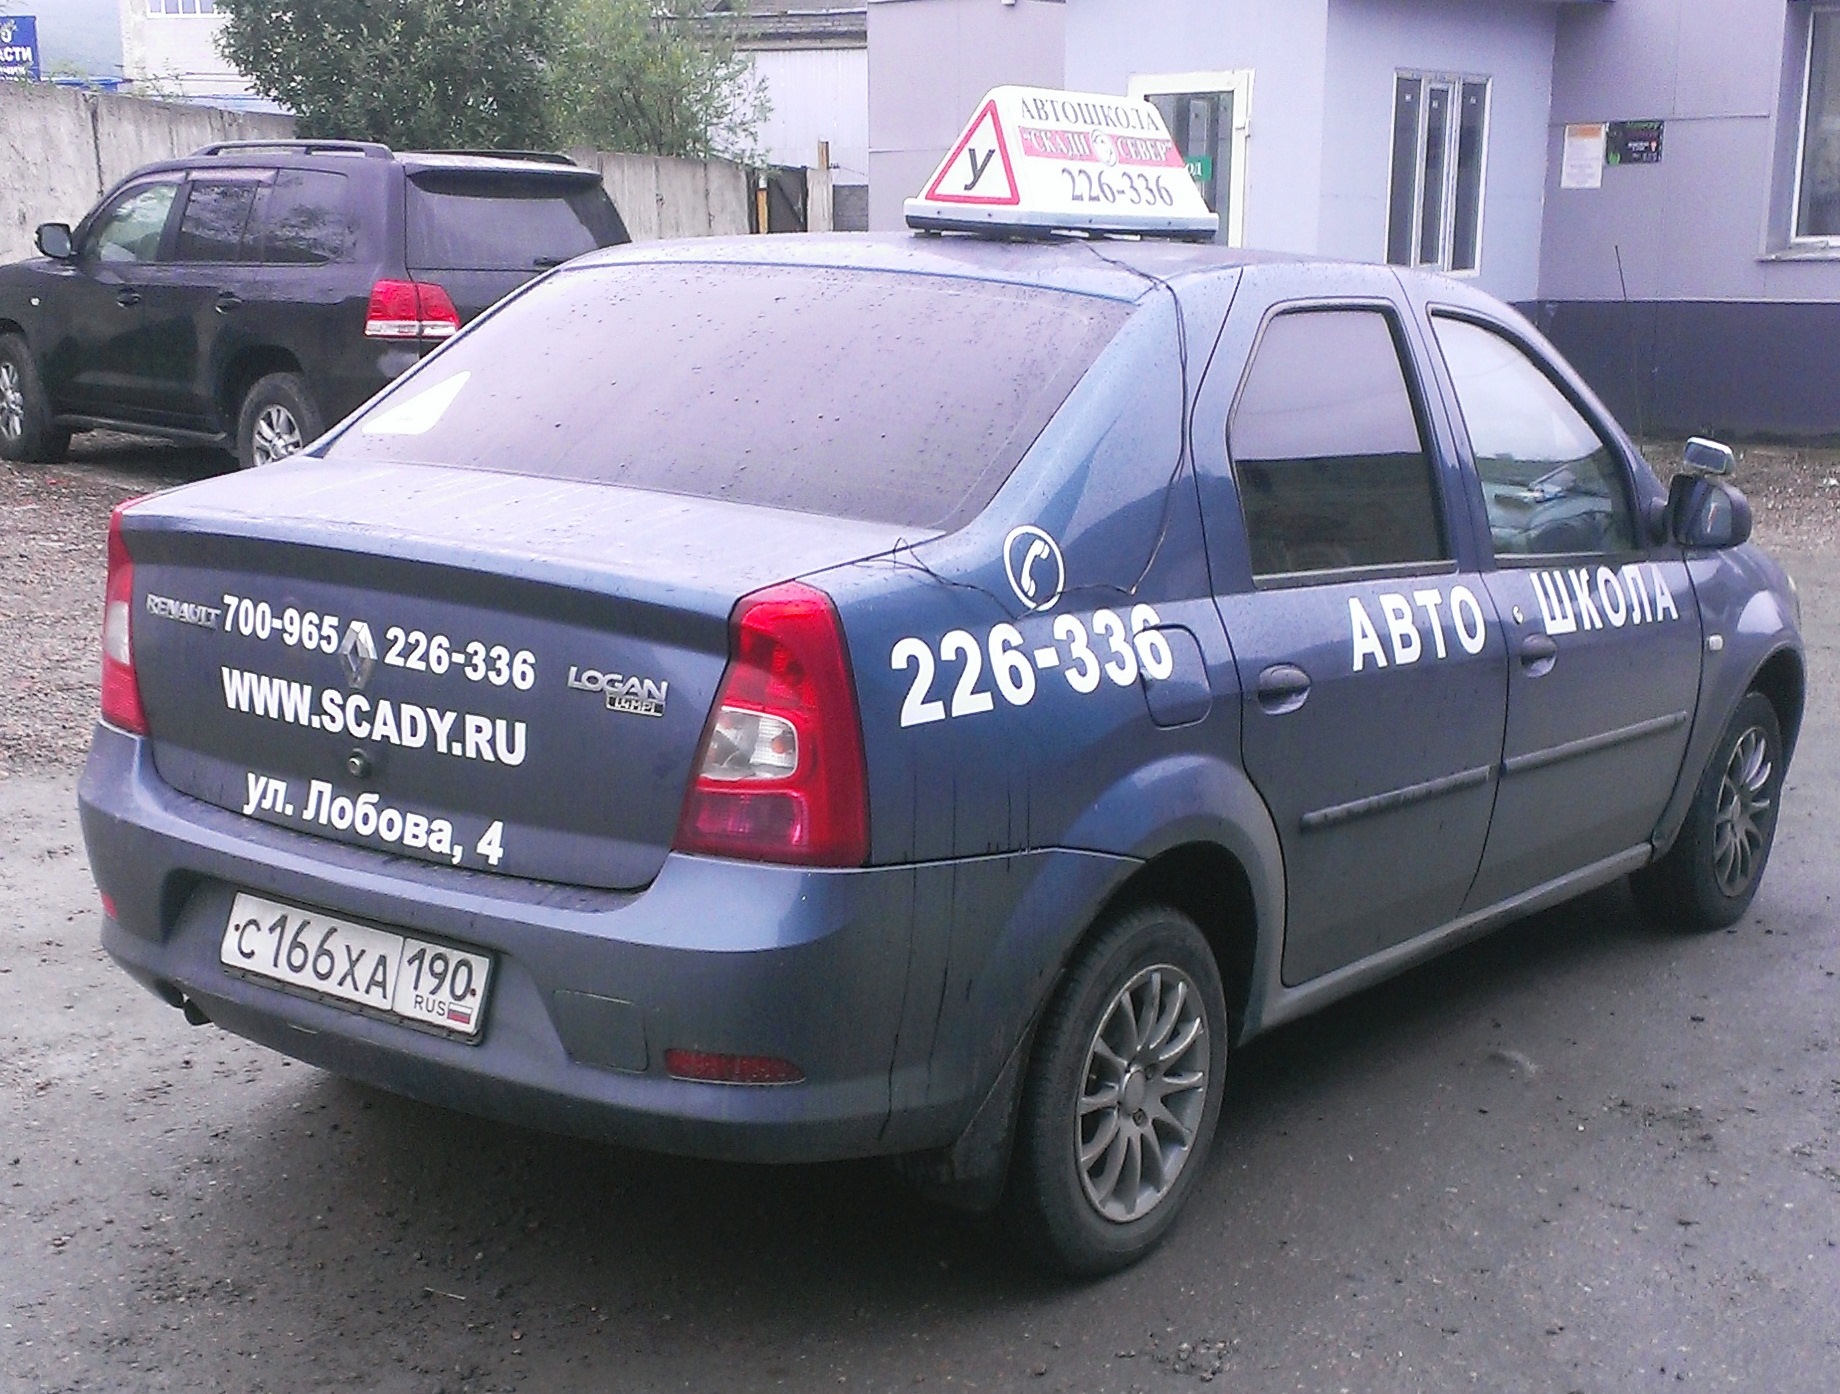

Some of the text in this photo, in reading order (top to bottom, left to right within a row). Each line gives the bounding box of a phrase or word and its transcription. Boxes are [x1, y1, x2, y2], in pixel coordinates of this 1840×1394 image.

[1021, 97, 1159, 131] АВТОШКОЛА
[964, 147, 996, 191] У
[1062, 167, 1174, 206] 226-336
[146, 594, 221, 630] RENAULT
[1349, 564, 1679, 671] АВТО ШКОЛА
[223, 594, 536, 691] 700-965 226-336
[891, 603, 1174, 728] 226-336
[567, 666, 669, 700] LOGAN
[221, 666, 527, 766] WWW.SCADY.RU
[243, 772, 504, 866] ул. Лобова, 4
[407, 947, 473, 1001] 190
[415, 994, 446, 1017] RUS
